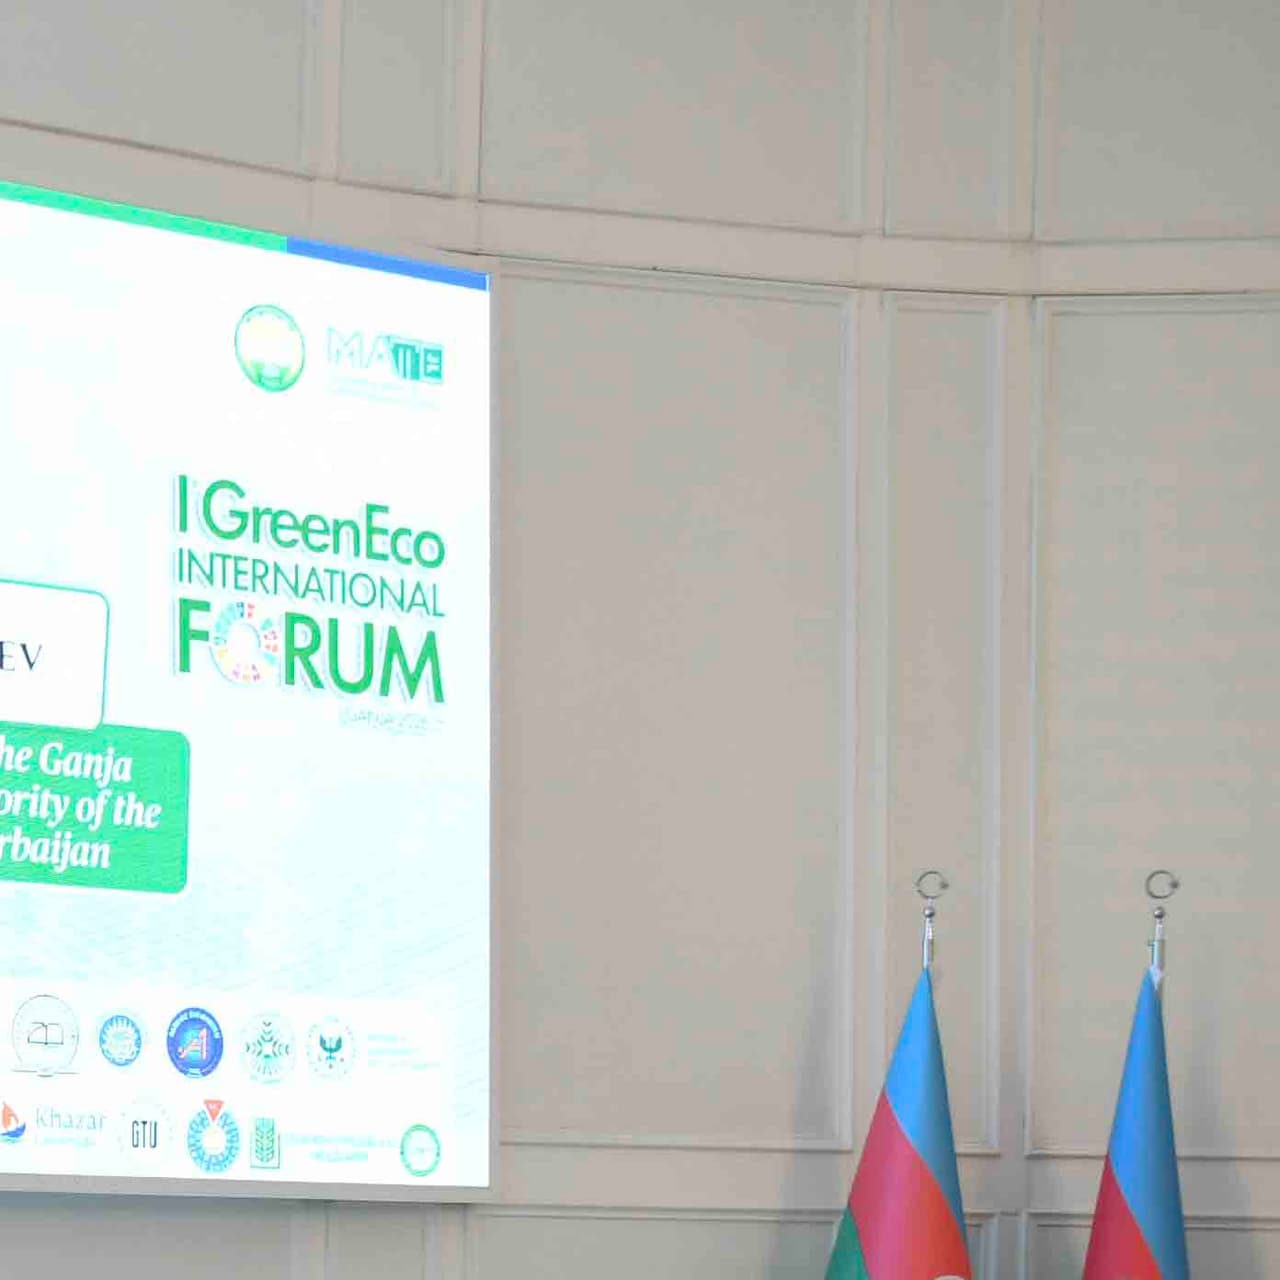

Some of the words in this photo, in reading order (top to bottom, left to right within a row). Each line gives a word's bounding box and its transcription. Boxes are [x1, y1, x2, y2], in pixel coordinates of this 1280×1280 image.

[178, 474, 188, 532] I
[203, 479, 445, 568] GreenEco
[178, 547, 446, 618] INTERNATIONAL
[178, 598, 445, 703] FORUM
[38, 742, 133, 788] Ganja
[75, 785, 110, 833] of
[111, 793, 162, 829] the
[34, 1106, 106, 1133] Khazar
[131, 1119, 158, 1149] GTU
